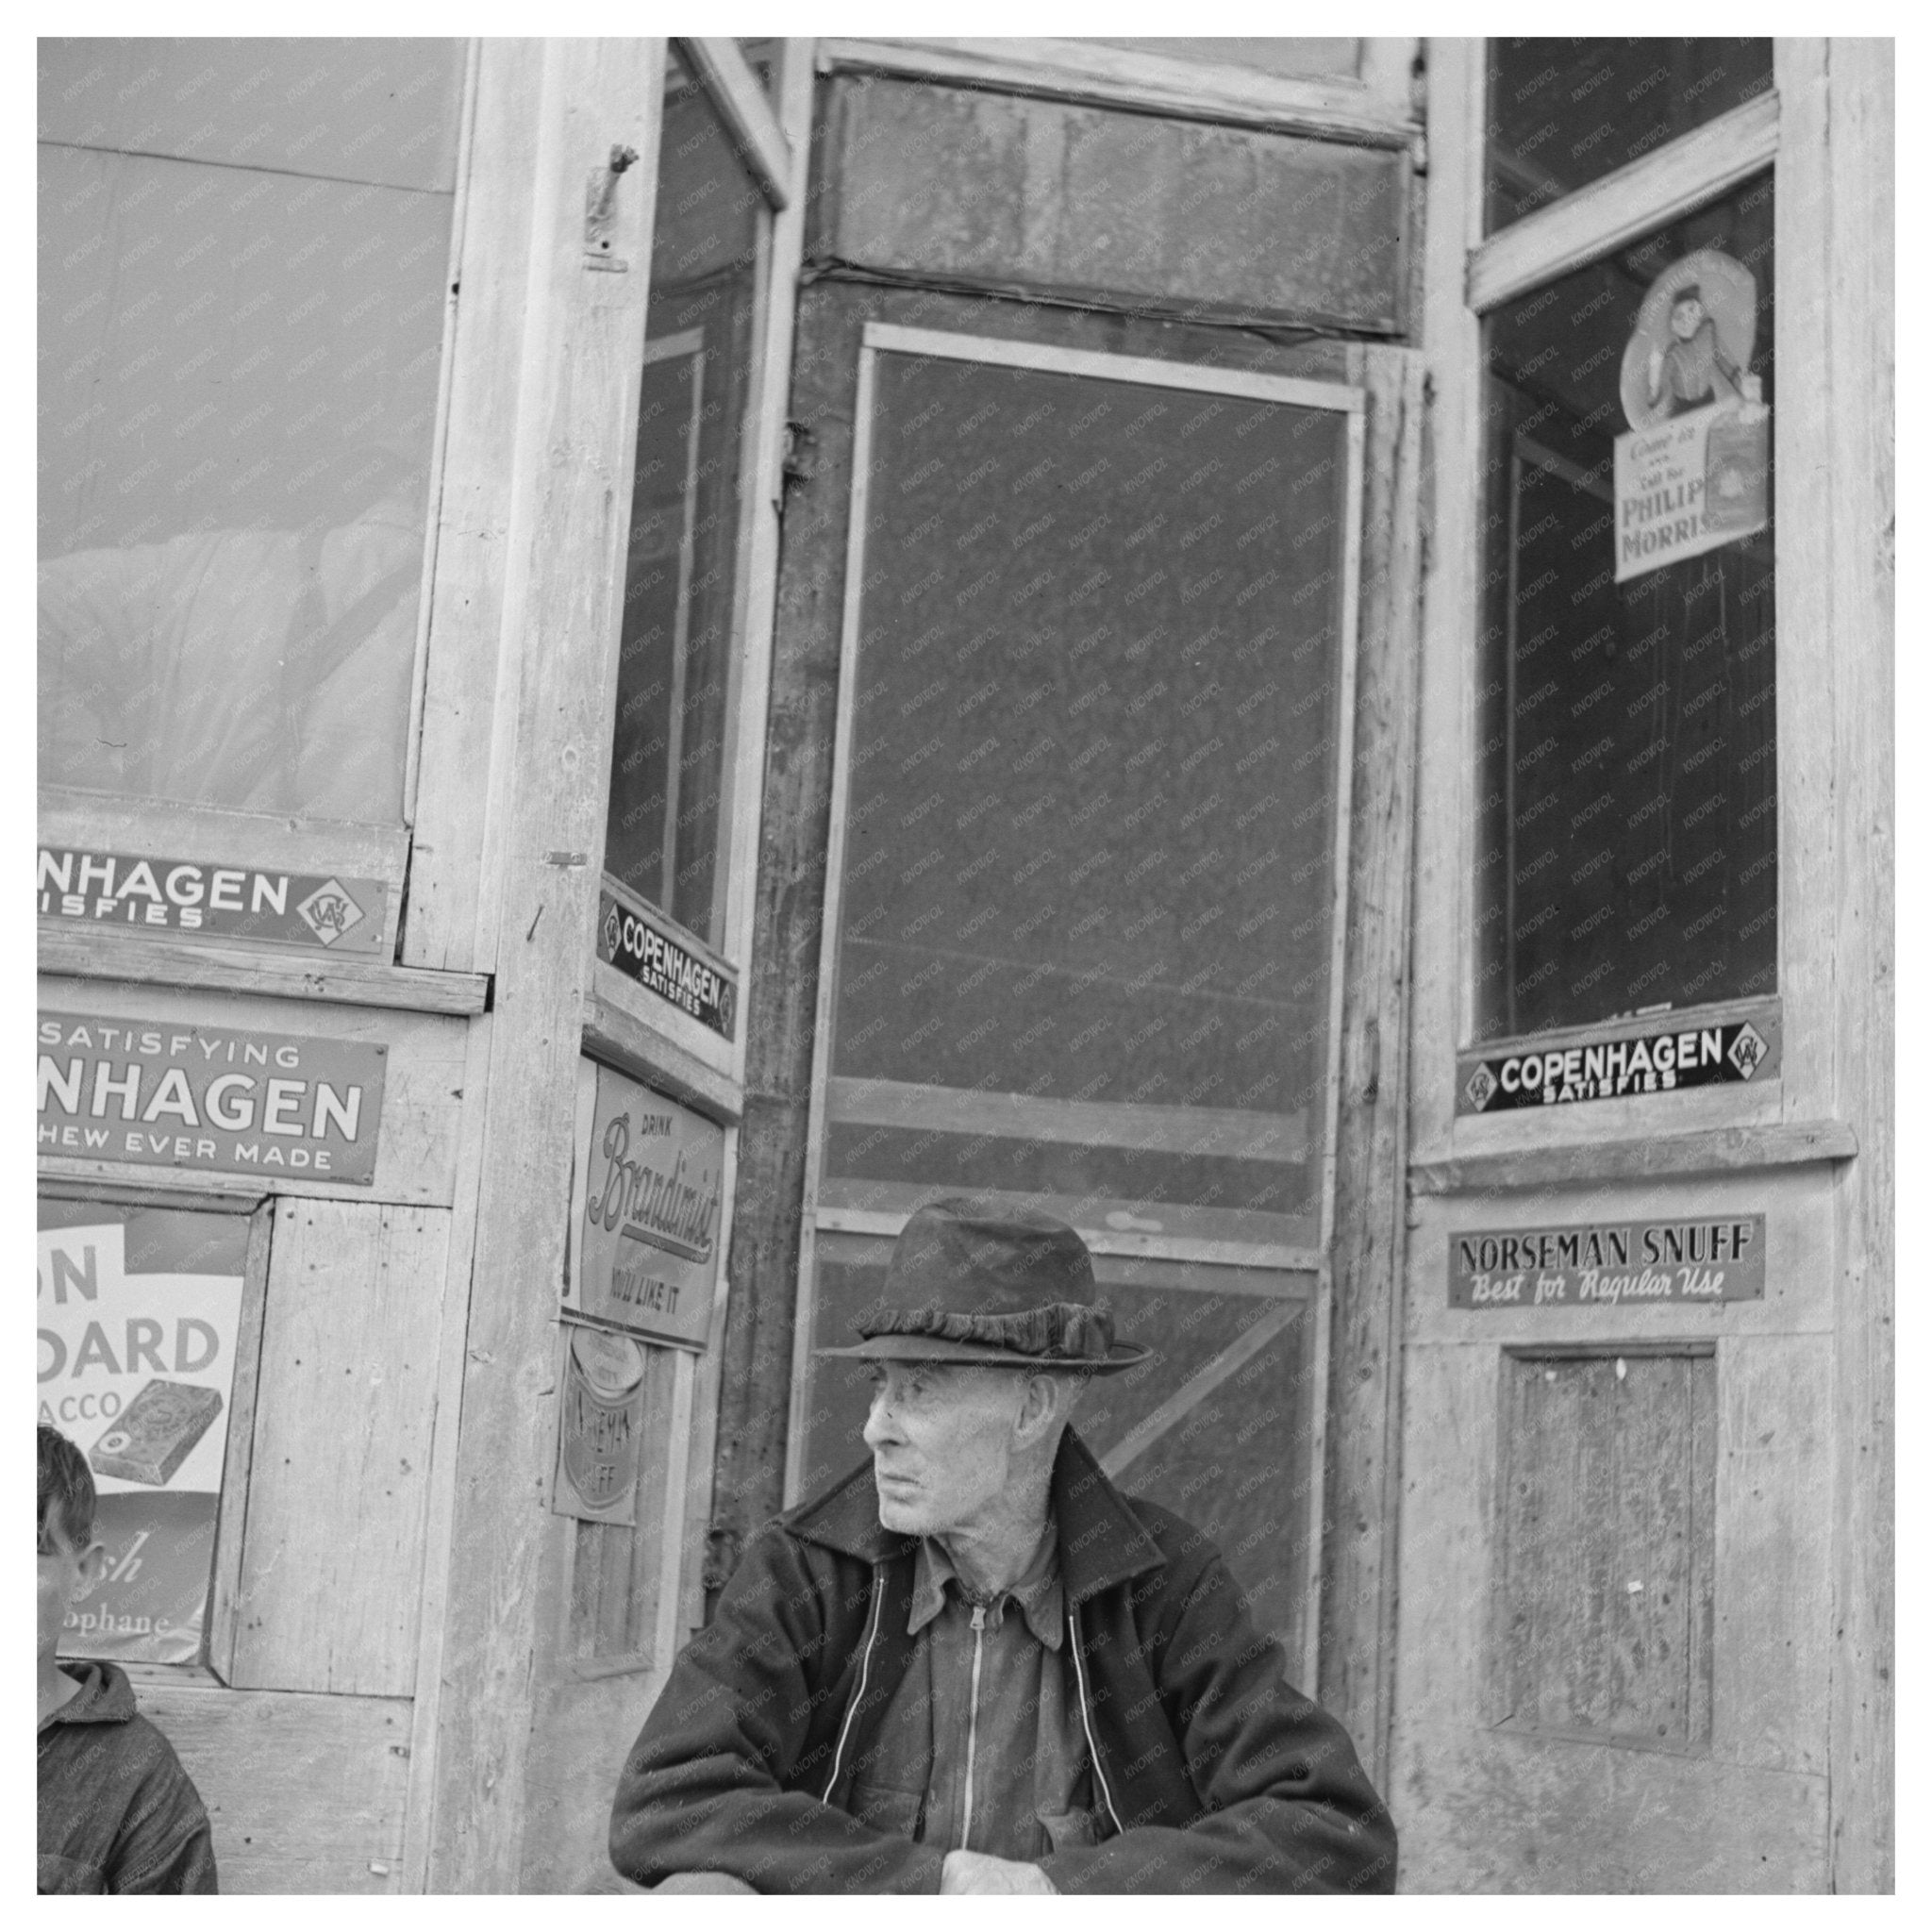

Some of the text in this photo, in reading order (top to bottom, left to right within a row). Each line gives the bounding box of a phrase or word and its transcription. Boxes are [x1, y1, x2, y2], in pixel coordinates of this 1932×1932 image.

[1622, 478, 1705, 528] PHILIP
[37, 850, 289, 916] NHAGEN
[624, 915, 720, 1009] COPENHAGEN
[642, 965, 701, 1016] SATISFIES
[38, 1022, 300, 1068] SATISFYING
[1501, 1027, 1723, 1092] COPENHAGEN
[37, 1055, 363, 1143] NHAGEN
[1543, 1069, 1676, 1104] SATISFIES
[38, 1124, 332, 1171] HEW EVER MADE
[641, 1113, 674, 1137] DRINK
[1459, 1223, 1755, 1274] NORSEMAN SNUFF
[37, 1244, 98, 1305] N
[1471, 1266, 1725, 1306] Best for Regular Use
[666, 1285, 680, 1315] IT
[38, 1391, 122, 1426] ACCO
[62, 1603, 171, 1638] ophane
